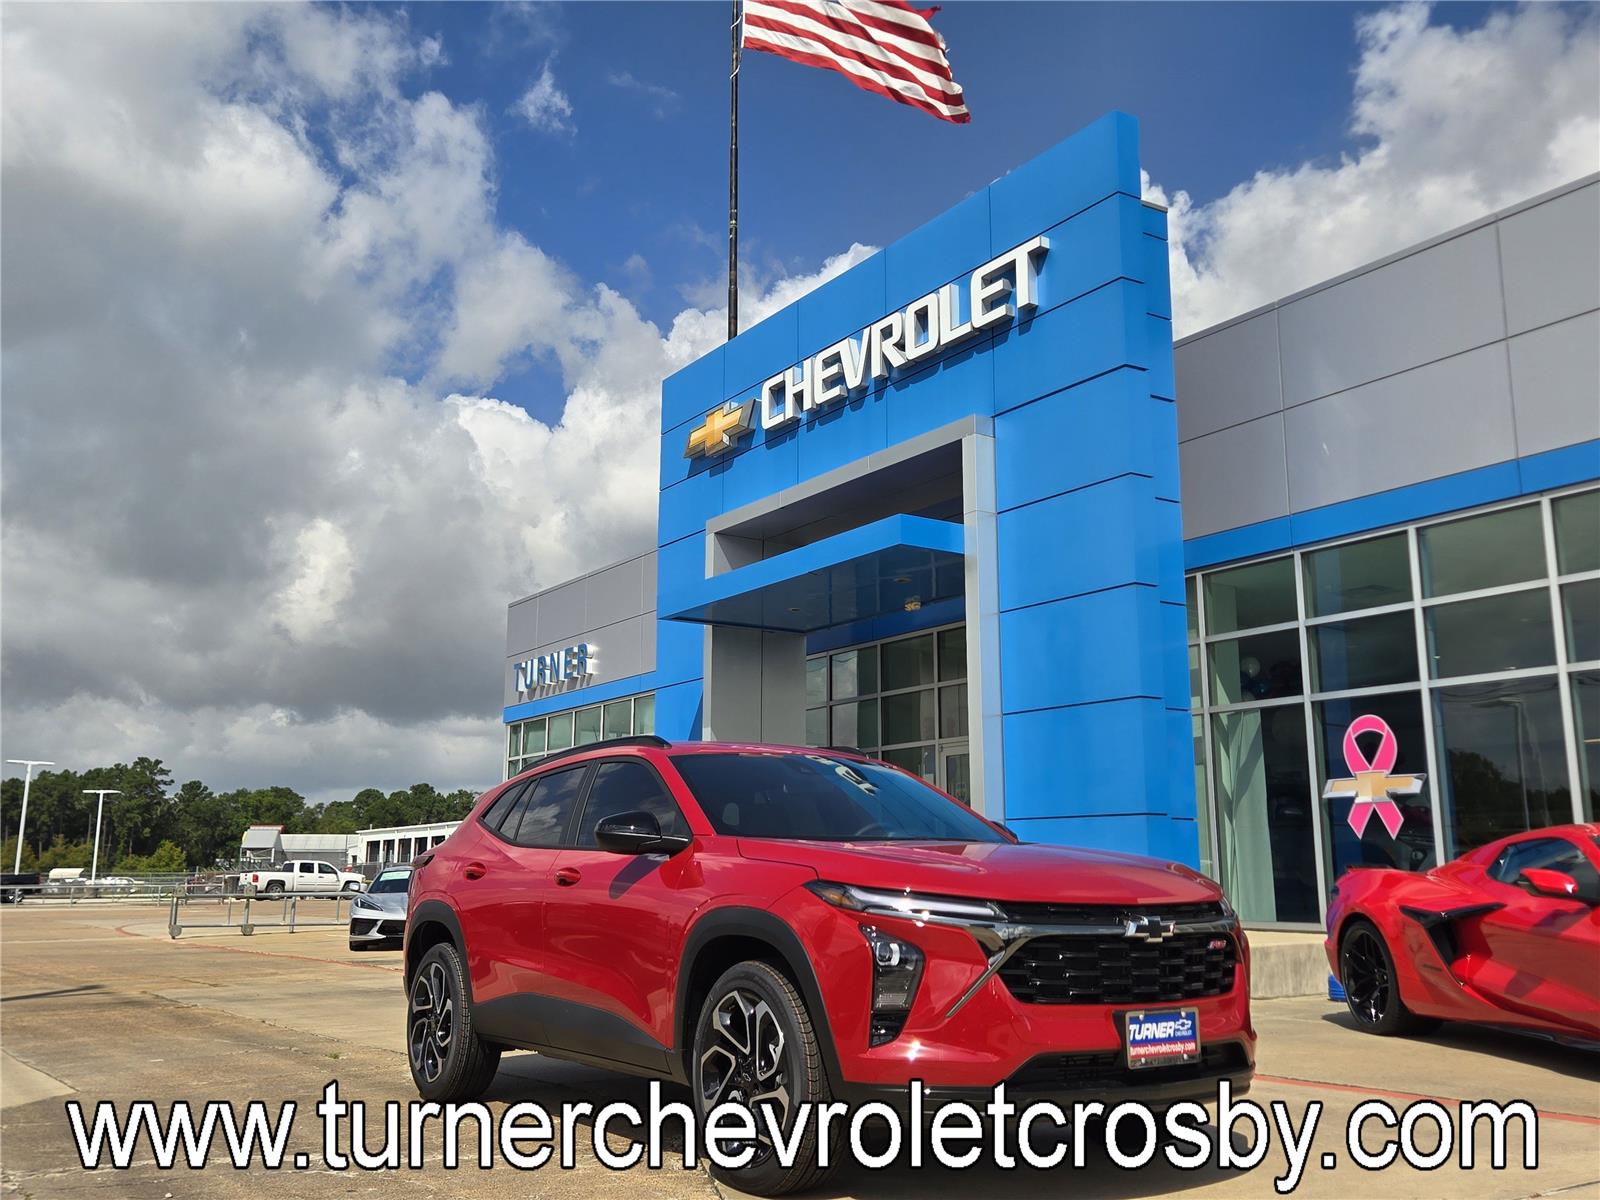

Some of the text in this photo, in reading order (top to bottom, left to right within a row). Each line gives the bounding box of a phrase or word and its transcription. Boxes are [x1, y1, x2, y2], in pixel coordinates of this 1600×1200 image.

[761, 235, 1050, 430] CHEVROLET
[513, 643, 594, 692] TURNER
[1129, 1020, 1174, 1041] TURNER
[1130, 1041, 1196, 1057] turnerchevroletcrosby.com
